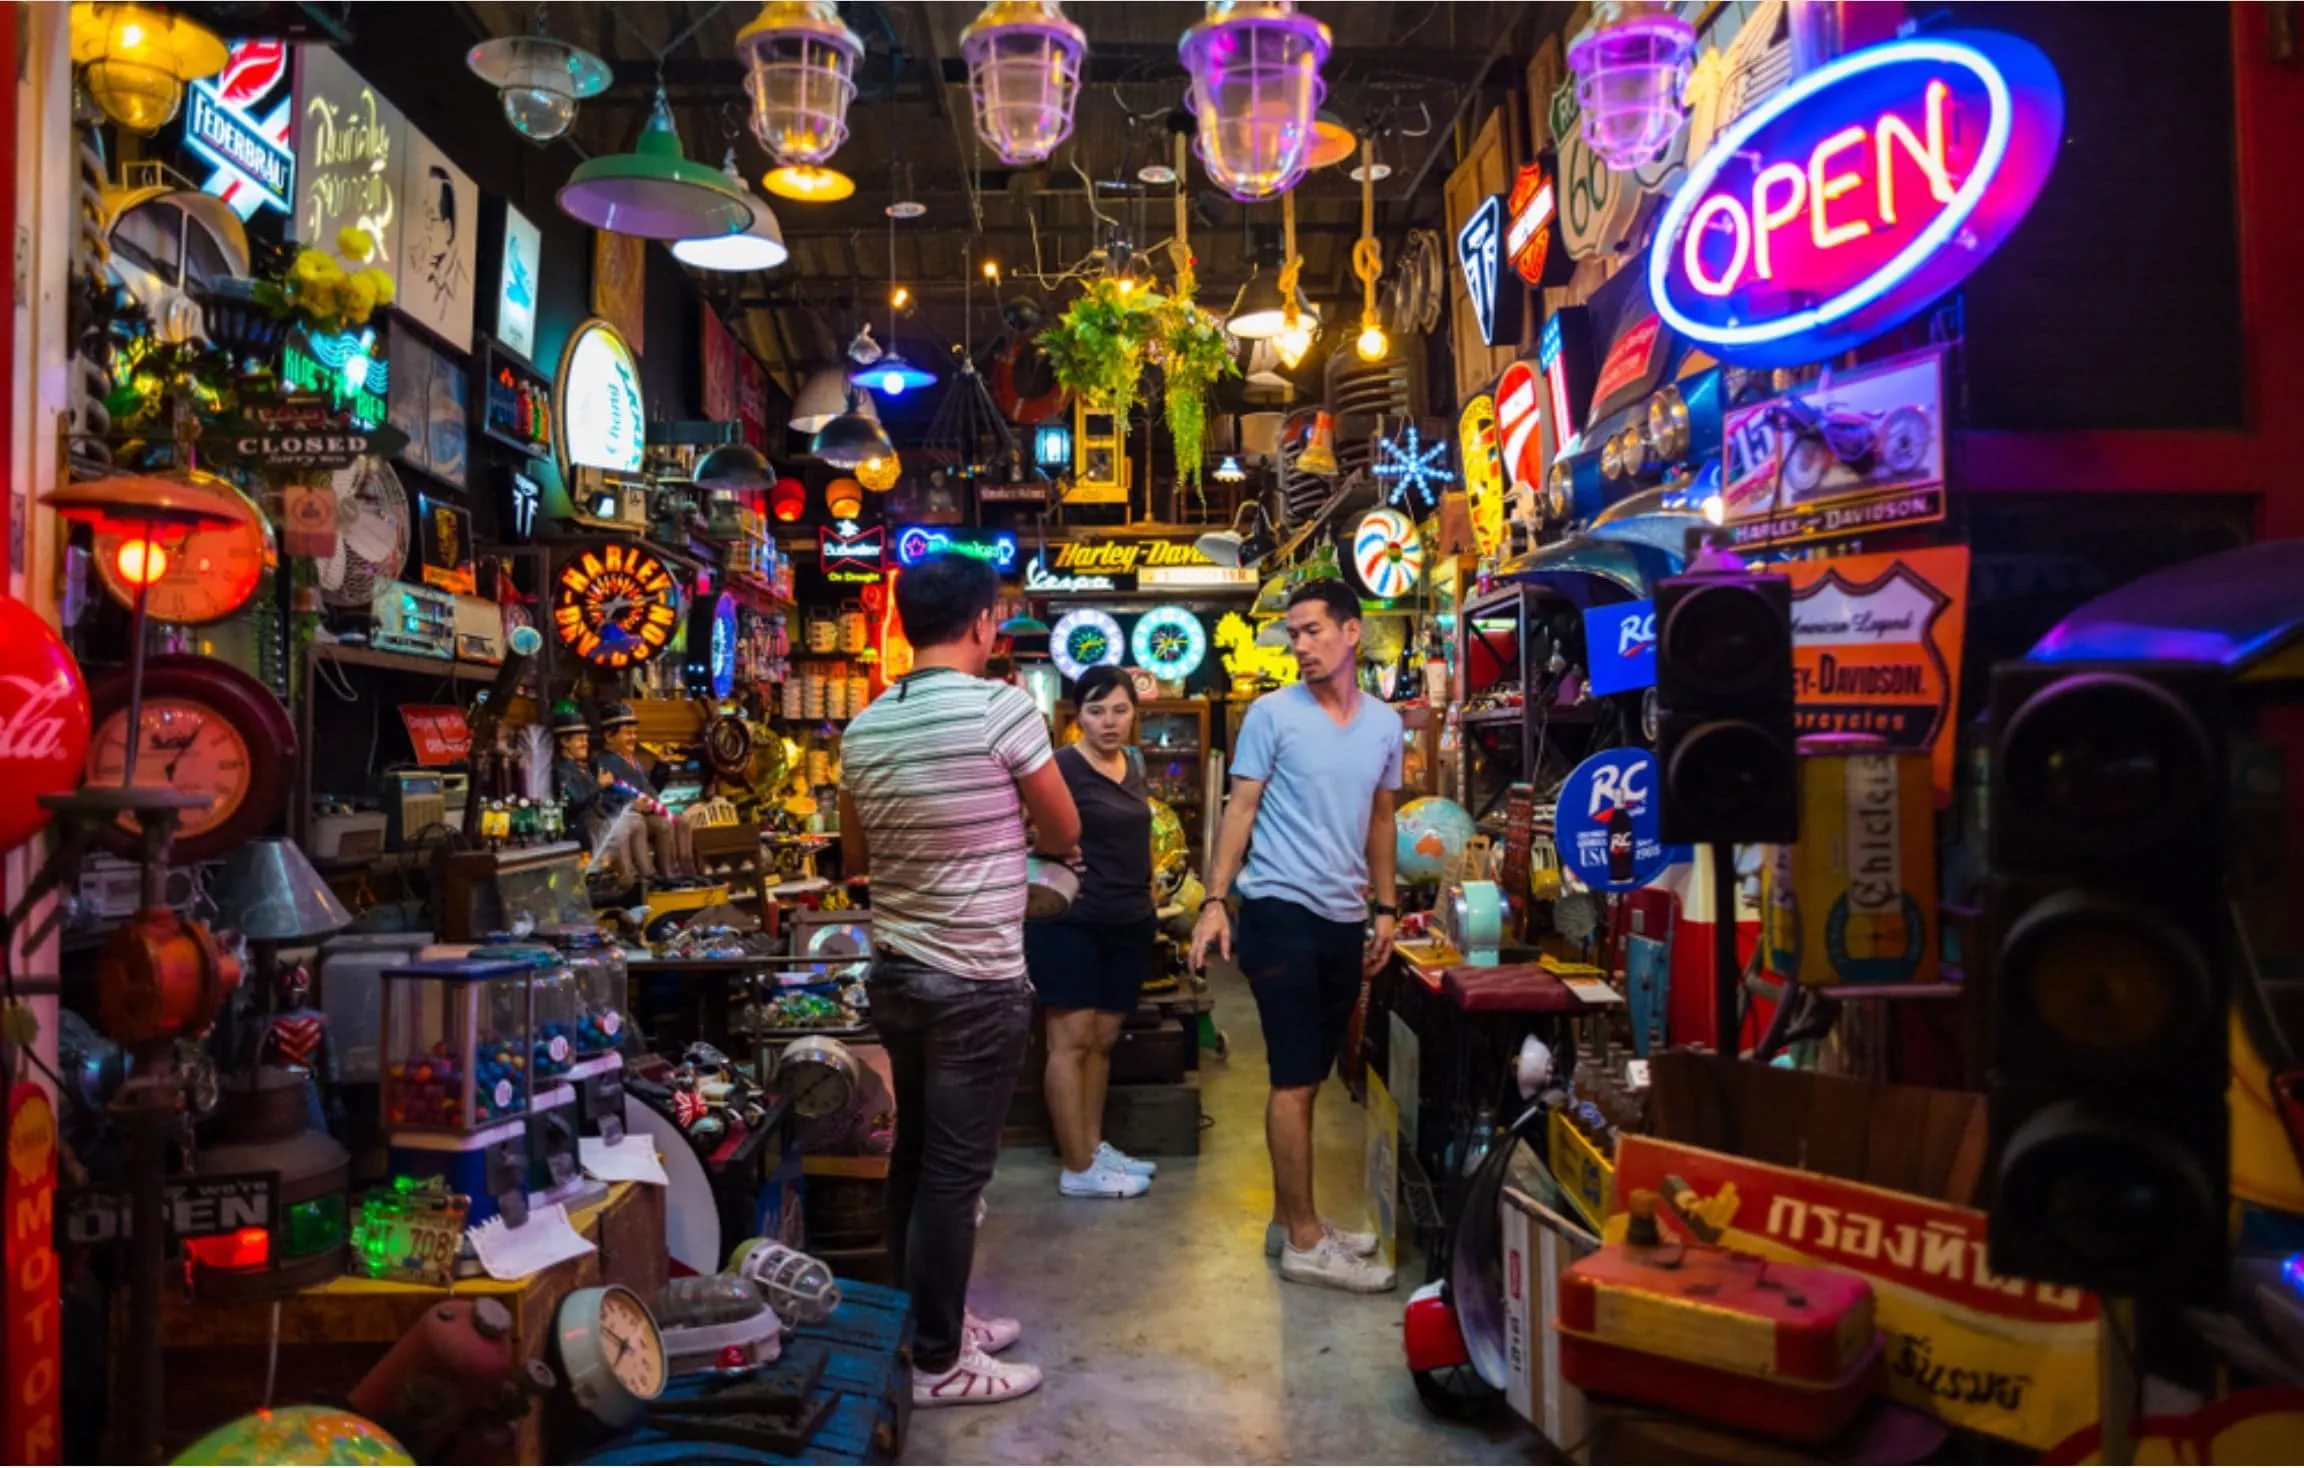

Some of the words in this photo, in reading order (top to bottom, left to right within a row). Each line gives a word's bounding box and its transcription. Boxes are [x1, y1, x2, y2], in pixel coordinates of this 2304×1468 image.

[1684, 79, 1957, 295] OPEN
[237, 436, 368, 454] CLOSED
[1588, 760, 1648, 817] RC
[68, 1194, 270, 1243] OEN
